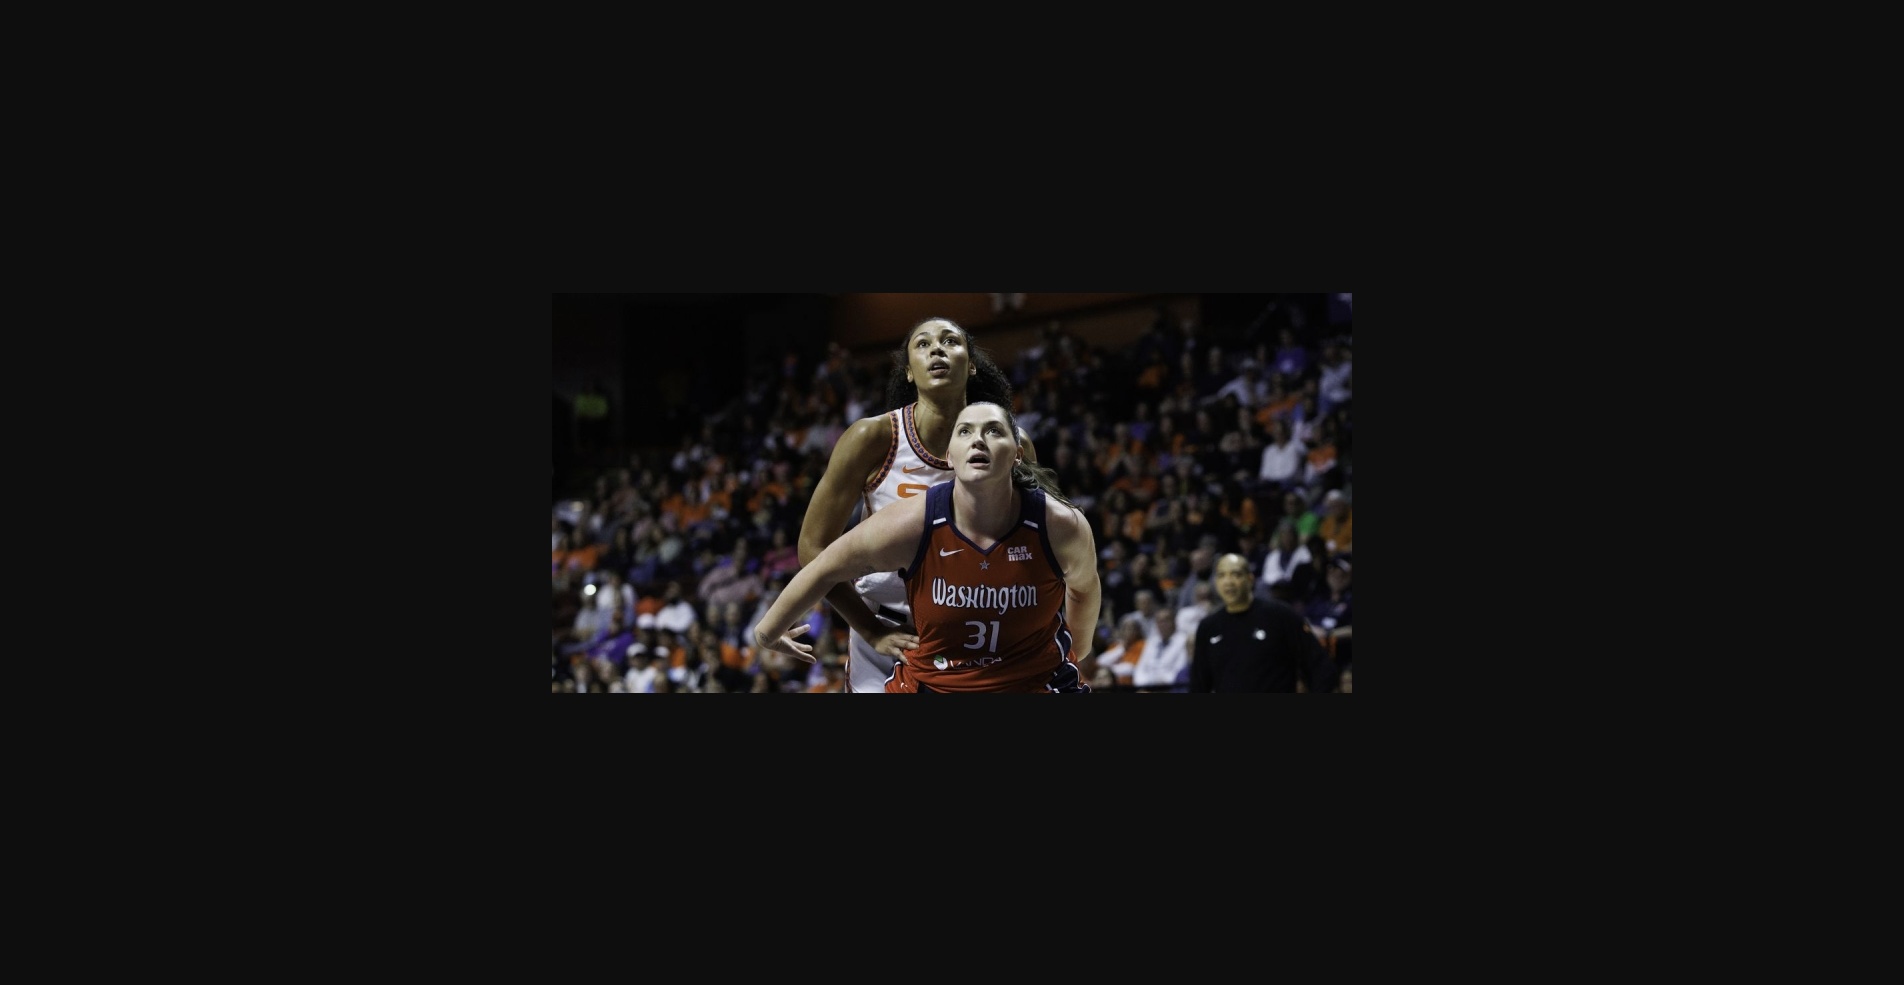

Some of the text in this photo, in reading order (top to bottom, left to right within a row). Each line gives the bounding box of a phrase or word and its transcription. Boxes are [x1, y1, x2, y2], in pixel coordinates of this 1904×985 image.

[1008, 546, 1027, 554] CAR
[1009, 553, 1032, 561] max
[932, 577, 1038, 615] Washington
[963, 620, 1000, 653] 31
